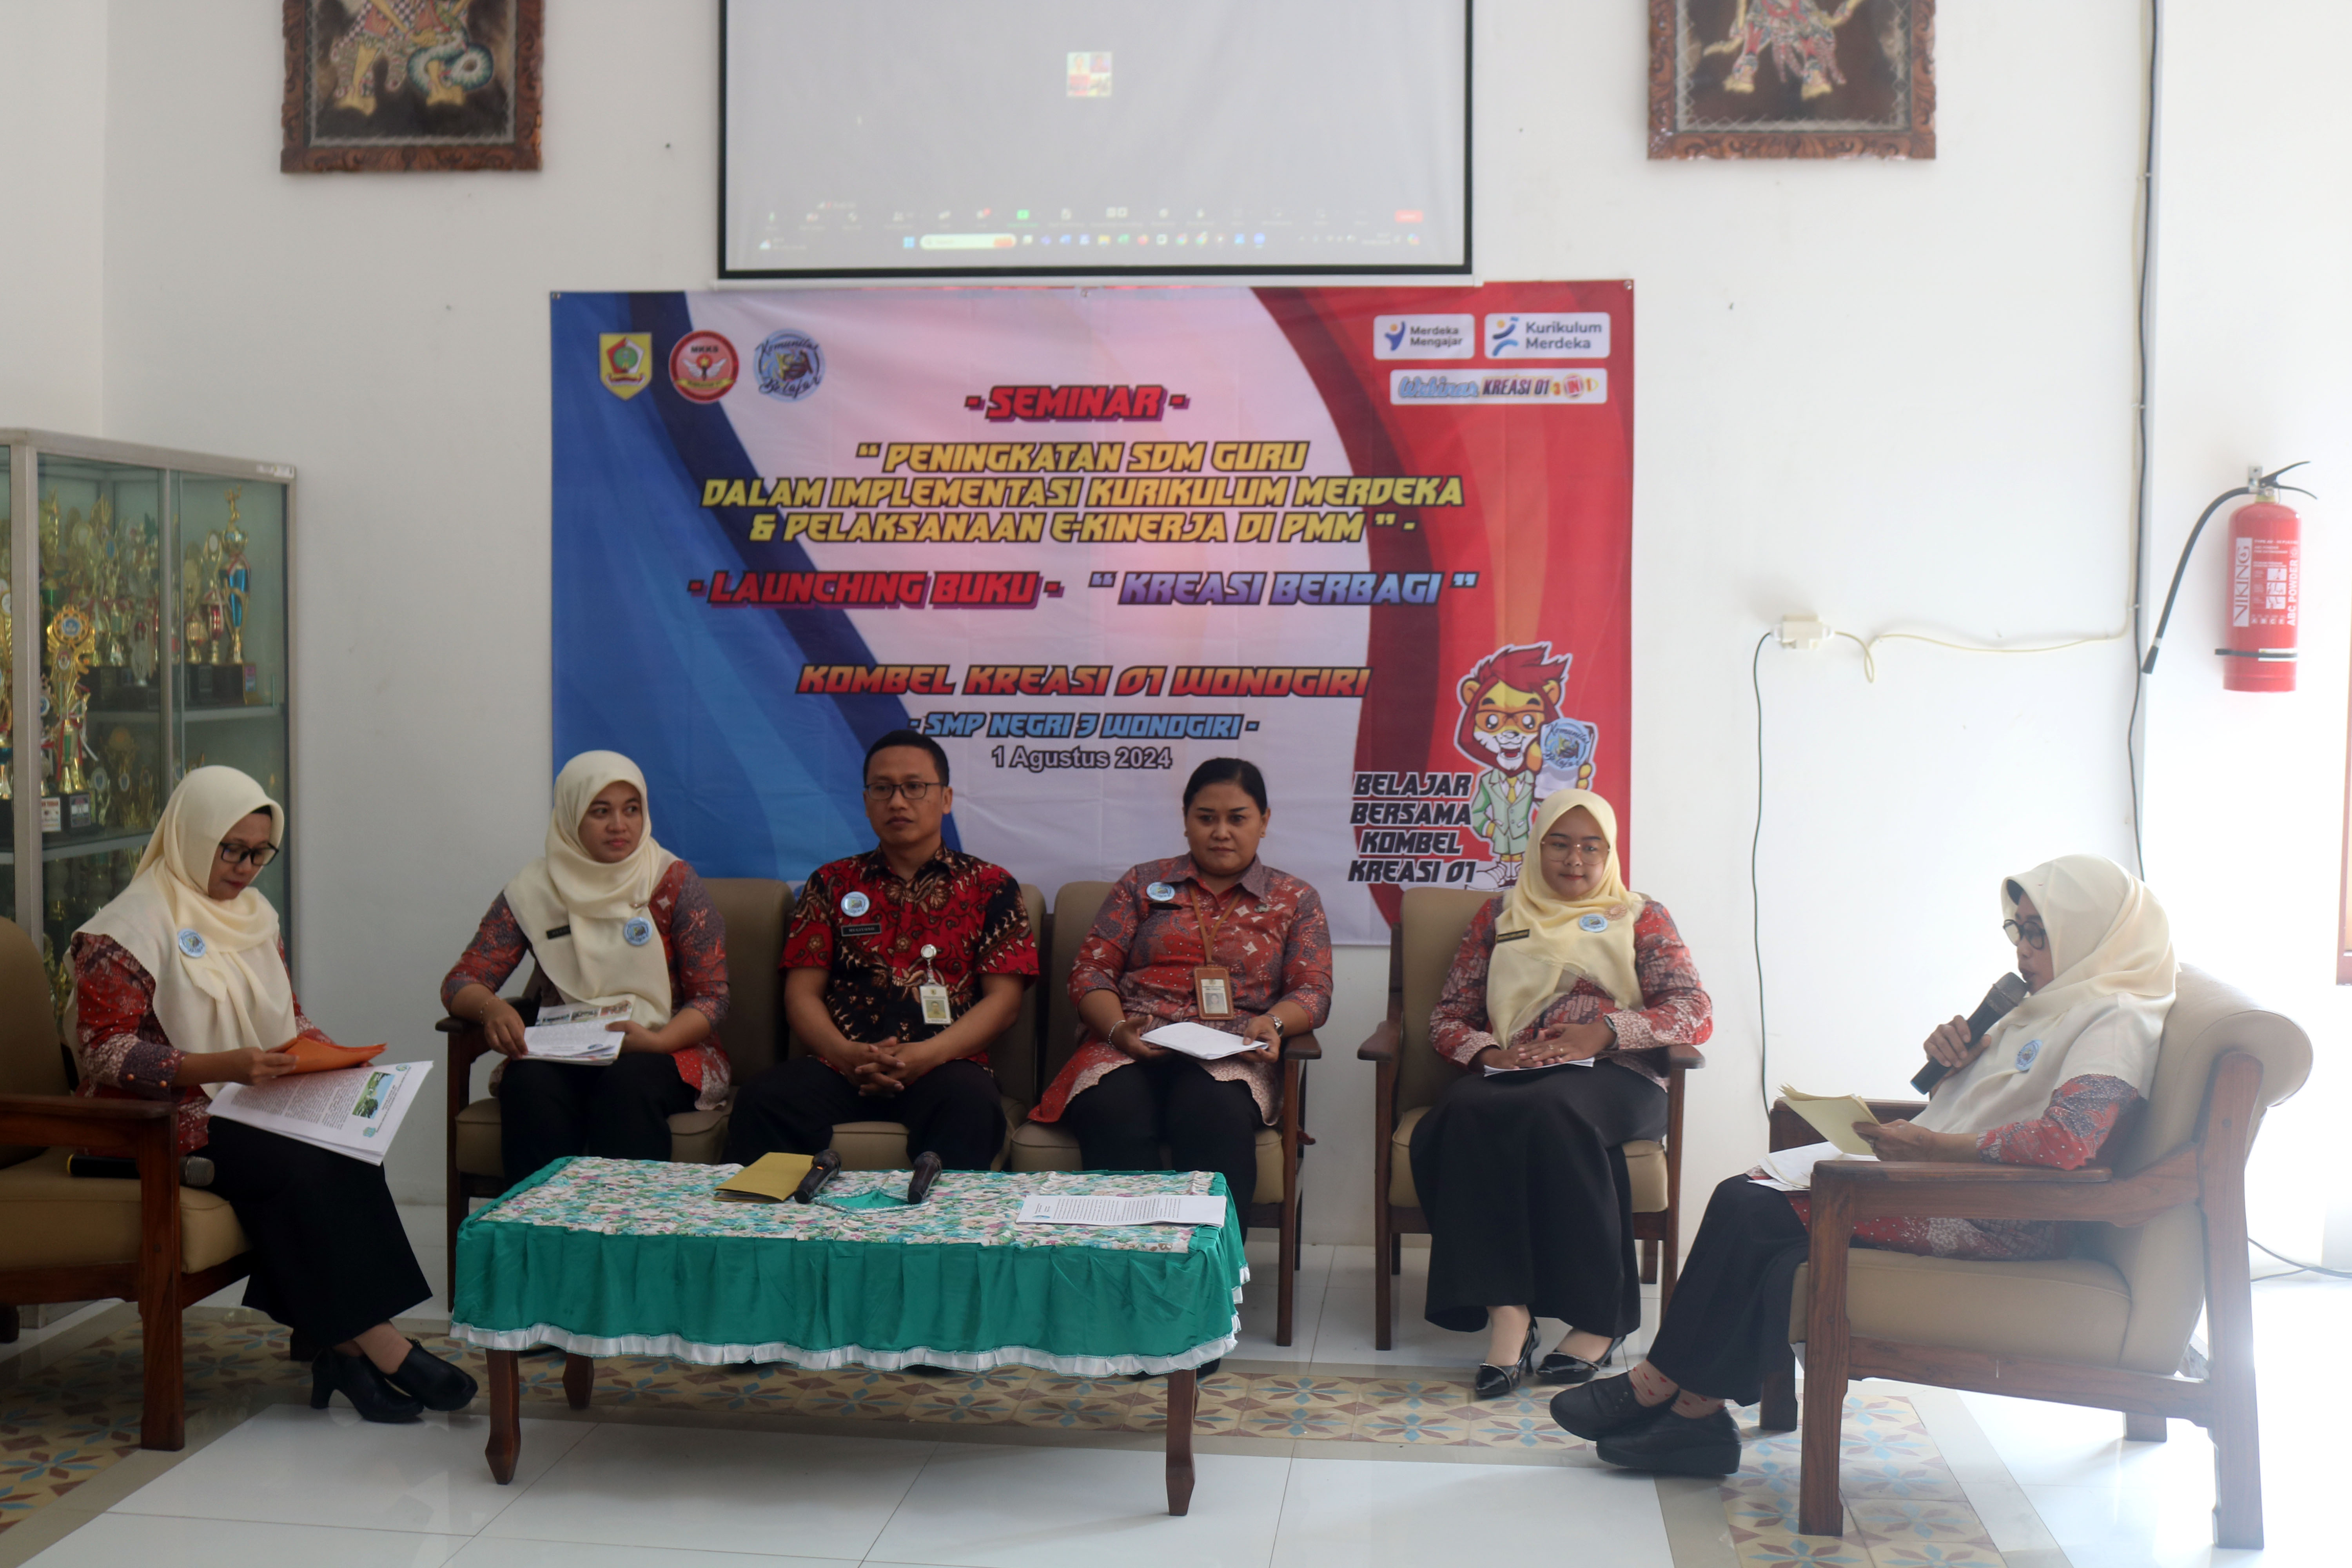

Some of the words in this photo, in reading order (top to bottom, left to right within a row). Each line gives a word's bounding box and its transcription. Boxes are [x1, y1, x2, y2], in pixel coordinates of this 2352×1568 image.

[1410, 327, 1459, 335] Merdeka
[1526, 321, 1602, 333] Kurikulum
[1410, 336, 1462, 347] Mengajar
[1526, 337, 1591, 349] Merdeka
[1399, 376, 1479, 397] Webinar
[1482, 379, 1532, 396] KREASI
[1534, 379, 1550, 395] 01
[985, 385, 1165, 419] SEMINAR
[882, 442, 1125, 472] PENINGKATAN
[1127, 441, 1207, 471] SDM
[1211, 441, 1310, 471] GURU
[701, 478, 826, 508] DALAM
[828, 477, 1084, 507] IMPLEMENTASI
[1085, 477, 1291, 507] KURIKULUM
[1291, 476, 1465, 506] MERDEKA
[749, 514, 776, 541] &
[783, 512, 1047, 542] PELAKSANAAN
[1050, 512, 1227, 542] E-KINERJA
[1234, 512, 1277, 542] DI
[1277, 512, 1367, 542] PMM
[707, 571, 928, 604] LAUNCHING
[929, 571, 1040, 605] BUKU
[1118, 571, 1267, 605] KREASI
[1268, 571, 1445, 605] BERBAGI
[2234, 546, 2250, 622] VIKING
[2288, 559, 2299, 603] POWDER
[2287, 605, 2297, 626] ABC
[795, 664, 957, 695] KOMBEL
[962, 666, 1113, 696] KREASI
[1113, 666, 1169, 696] 01
[1168, 666, 1373, 697] WONOGIRI
[921, 712, 988, 737] SMP
[986, 713, 1076, 737] NEGRI
[1074, 713, 1100, 738] 3
[1099, 713, 1245, 739] WONOGIRI
[992, 746, 1004, 768] 1
[1009, 746, 1110, 773] Agustus
[1114, 747, 1172, 769] 2024
[1353, 773, 1472, 796] BELAJAR
[1350, 803, 1471, 825] BERSAMA
[1360, 831, 1462, 854] KOMBEL
[1348, 860, 1442, 882] KREASI
[1445, 860, 1476, 882] 01
